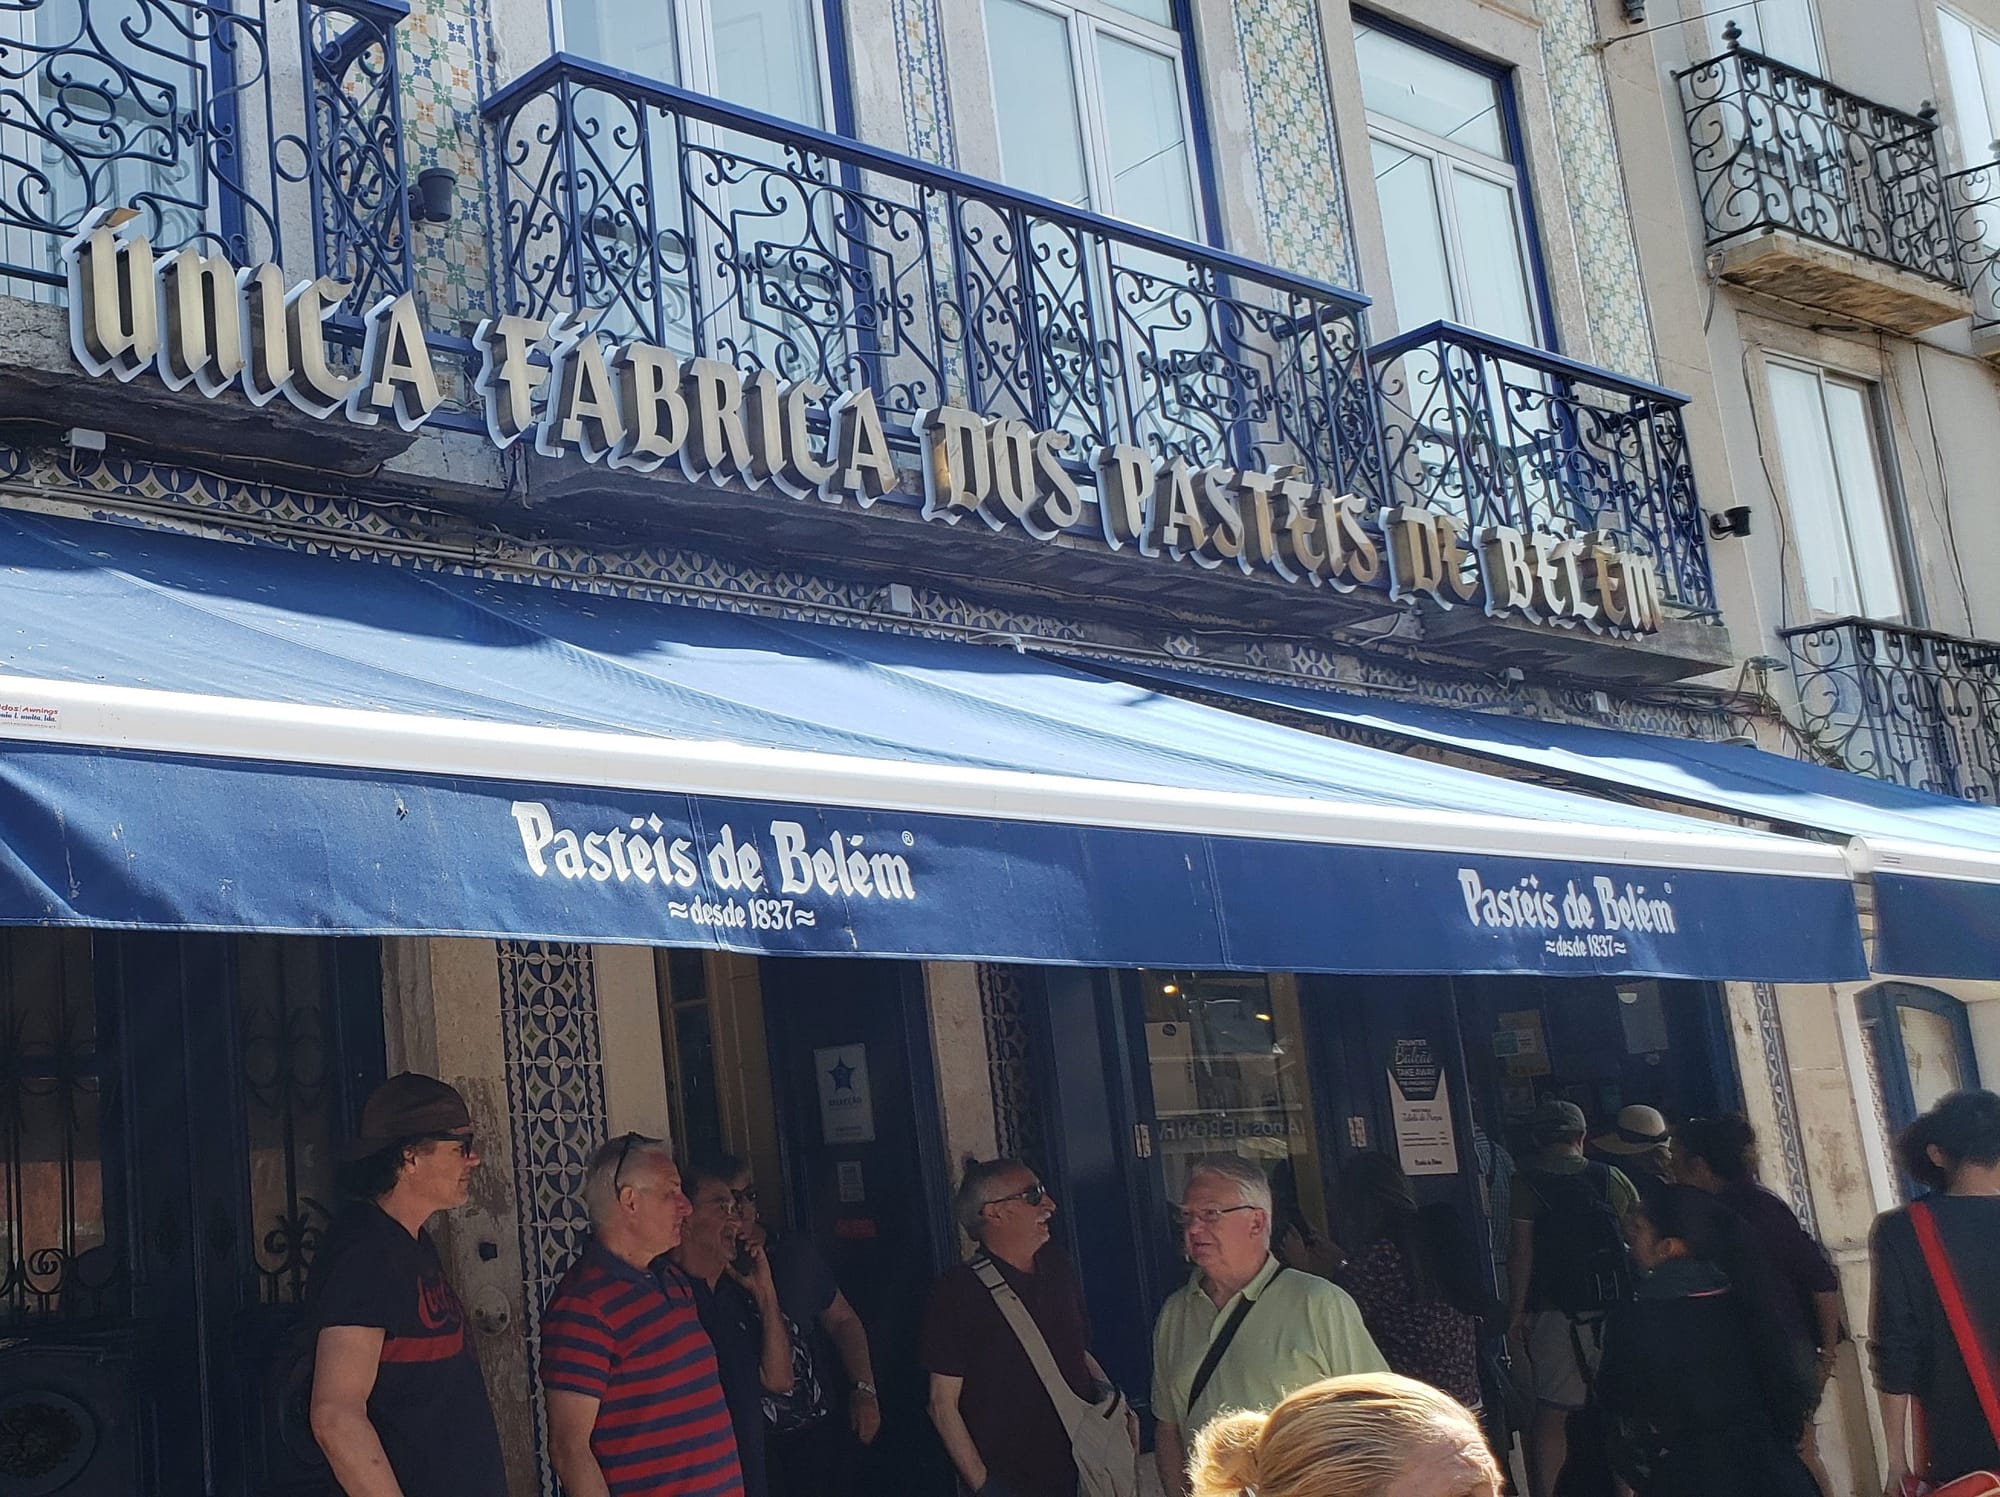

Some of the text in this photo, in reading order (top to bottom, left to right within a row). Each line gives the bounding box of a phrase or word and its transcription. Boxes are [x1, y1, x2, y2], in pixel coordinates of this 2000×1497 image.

[475, 308, 900, 507] FÁBRICA
[912, 405, 1082, 539] DOS
[1089, 444, 1378, 592] PASTÉIS
[1379, 506, 1479, 610] DE
[1473, 529, 1664, 641] BELÉM
[511, 800, 697, 888] Pastéis
[707, 823, 763, 892] de
[690, 896, 794, 930] desde 1837
[1458, 867, 1559, 929] Pastéis
[1563, 879, 1595, 930] de
[1556, 934, 1613, 957] desde 1837
